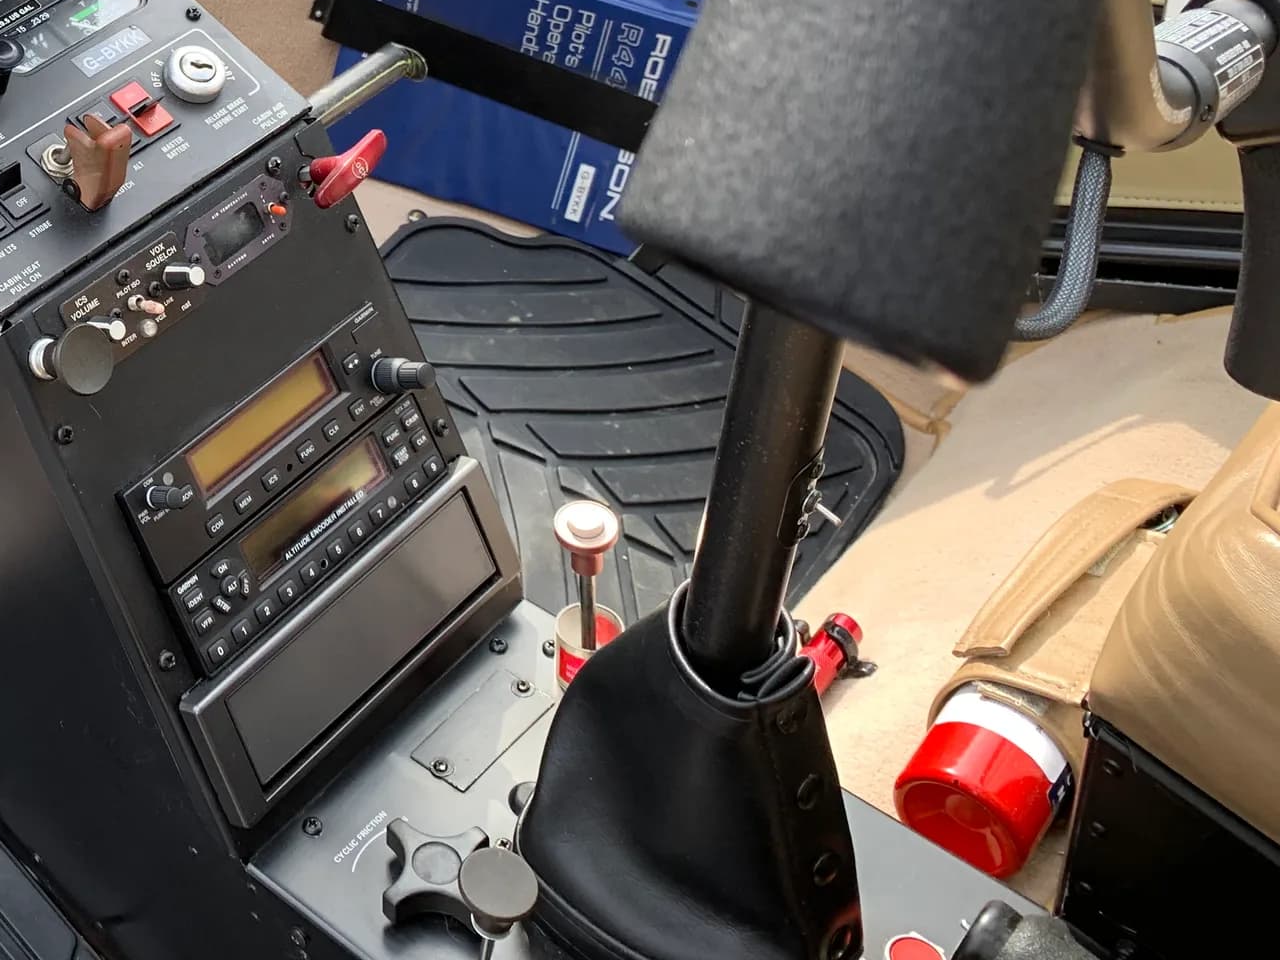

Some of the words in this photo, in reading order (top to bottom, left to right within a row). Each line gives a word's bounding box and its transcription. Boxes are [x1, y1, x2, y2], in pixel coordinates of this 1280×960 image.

[8, 11, 19, 21] US
[18, 4, 35, 15] GAL
[565, 9, 596, 68] Pilot's
[82, 30, 144, 71] G-BYKK
[152, 71, 163, 89] OFF
[204, 106, 227, 126] RELEASE
[225, 96, 246, 113] BRAKE
[213, 114, 234, 130] BEFORE
[232, 105, 249, 119] START
[252, 110, 273, 126] CABIN
[271, 101, 285, 113] AIR
[259, 117, 277, 130] PULL
[276, 110, 288, 119] ON
[161, 136, 185, 154] MASTER
[166, 142, 191, 161] BATTERY
[133, 161, 144, 172] ALT
[15, 197, 29, 209] OFF
[28, 220, 53, 238] STROBE
[5, 243, 17, 255] LTS
[149, 243, 166, 258] VOX
[145, 245, 177, 272] SQUELCH
[21, 260, 42, 277] HEAT
[9, 279, 31, 296] PULL
[29, 271, 43, 283] ON
[116, 285, 132, 299] PILOT
[129, 279, 141, 290] ISO
[74, 295, 89, 308] ICS
[69, 298, 100, 323] VOLUME
[353, 307, 375, 324] GARMIN
[121, 333, 138, 348] INTER
[353, 403, 367, 417] ENT
[328, 424, 341, 437] CLR
[386, 429, 400, 443] FUNC
[416, 435, 427, 446] CLR
[300, 444, 316, 460] FUNC
[238, 495, 253, 509] MEM
[210, 518, 225, 532] COM
[284, 531, 312, 561] ALTITUDE
[309, 510, 339, 540] ENCODER
[335, 490, 365, 519] INSTALLED
[217, 562, 229, 573] ON
[177, 574, 200, 595] GARMIN
[227, 580, 239, 592] ALT
[187, 593, 204, 609] IDENT
[215, 597, 232, 613] STBY
[201, 616, 215, 630] VFR
[333, 837, 360, 863] CYCLIC
[356, 810, 388, 841] FRICTION
